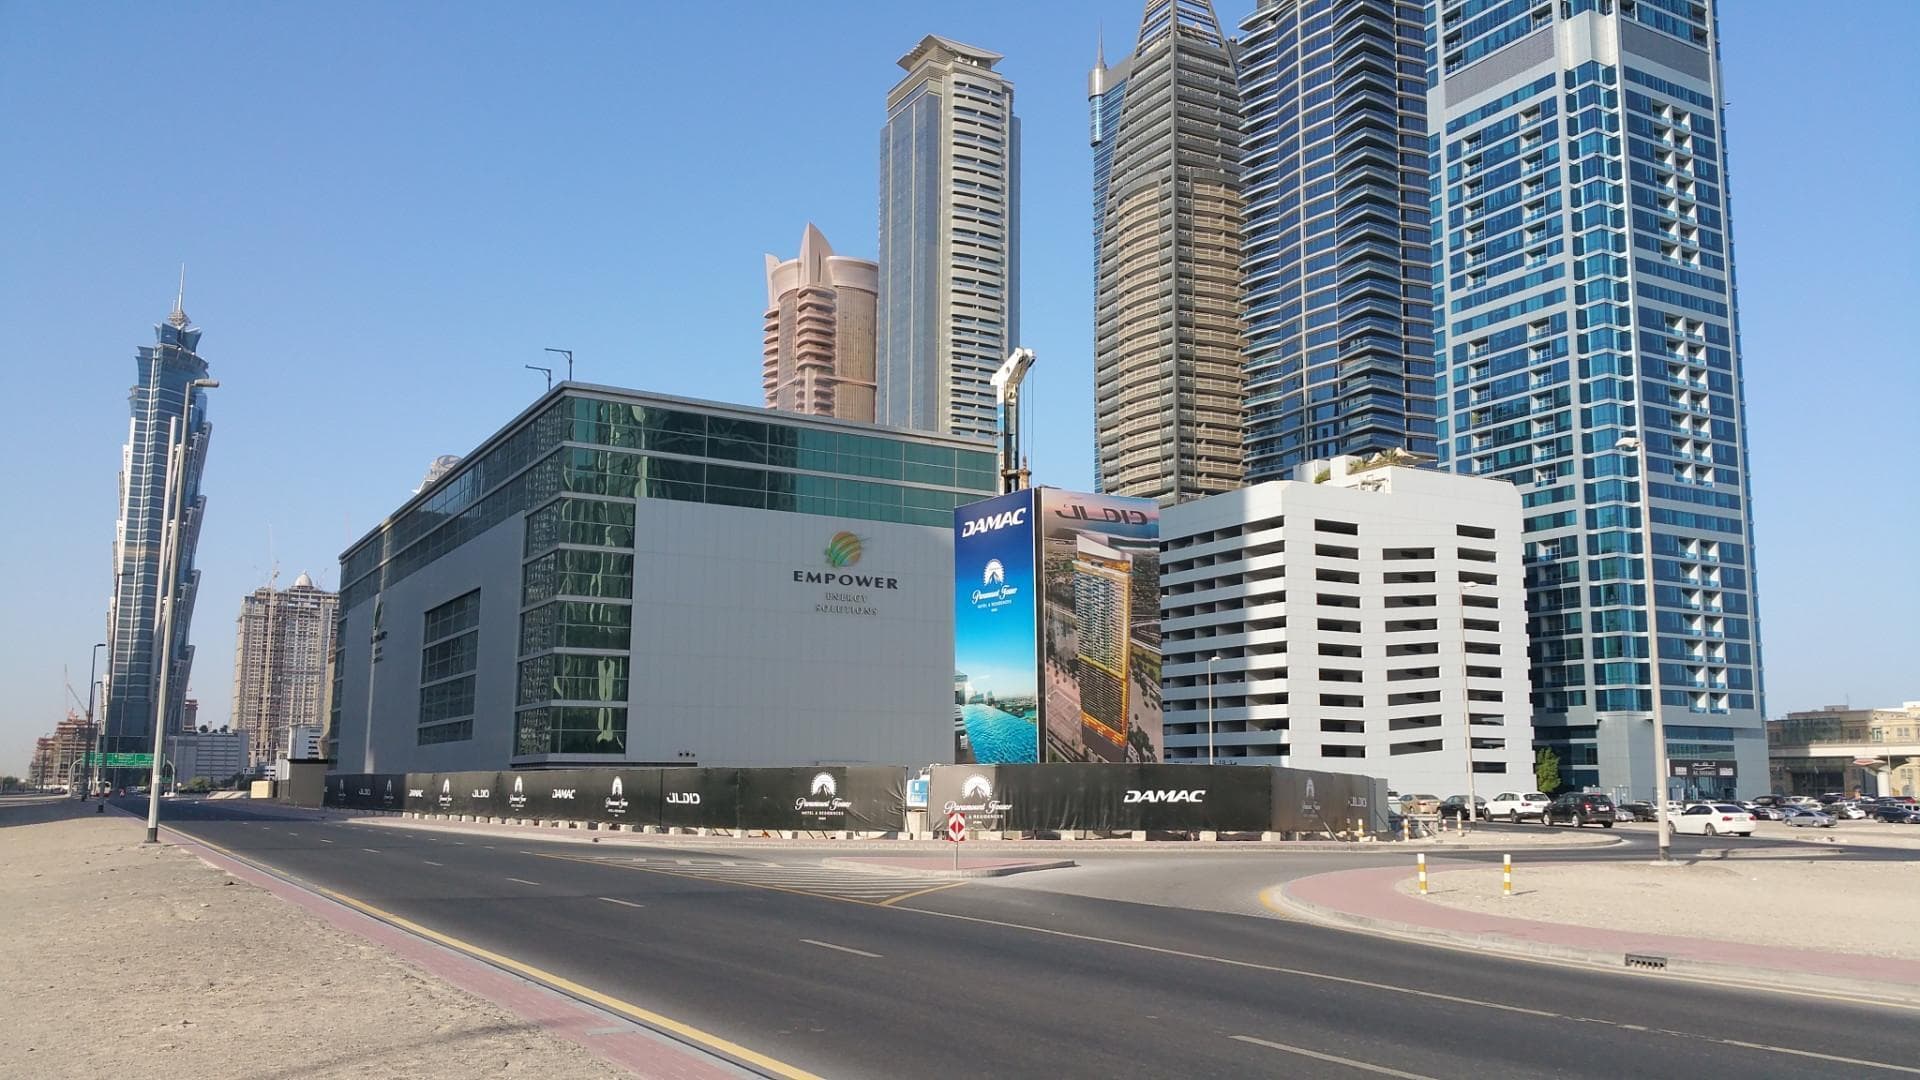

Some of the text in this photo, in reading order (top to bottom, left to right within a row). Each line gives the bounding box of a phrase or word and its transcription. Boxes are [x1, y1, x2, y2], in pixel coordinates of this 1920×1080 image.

[962, 507, 1027, 538] DAMAC
[793, 570, 898, 590] EMPOWER
[551, 789, 576, 799] DAMAC
[1123, 790, 1207, 803] DAMAC
[794, 797, 830, 811] Paramount
[943, 800, 1013, 815] Paramount Tower
